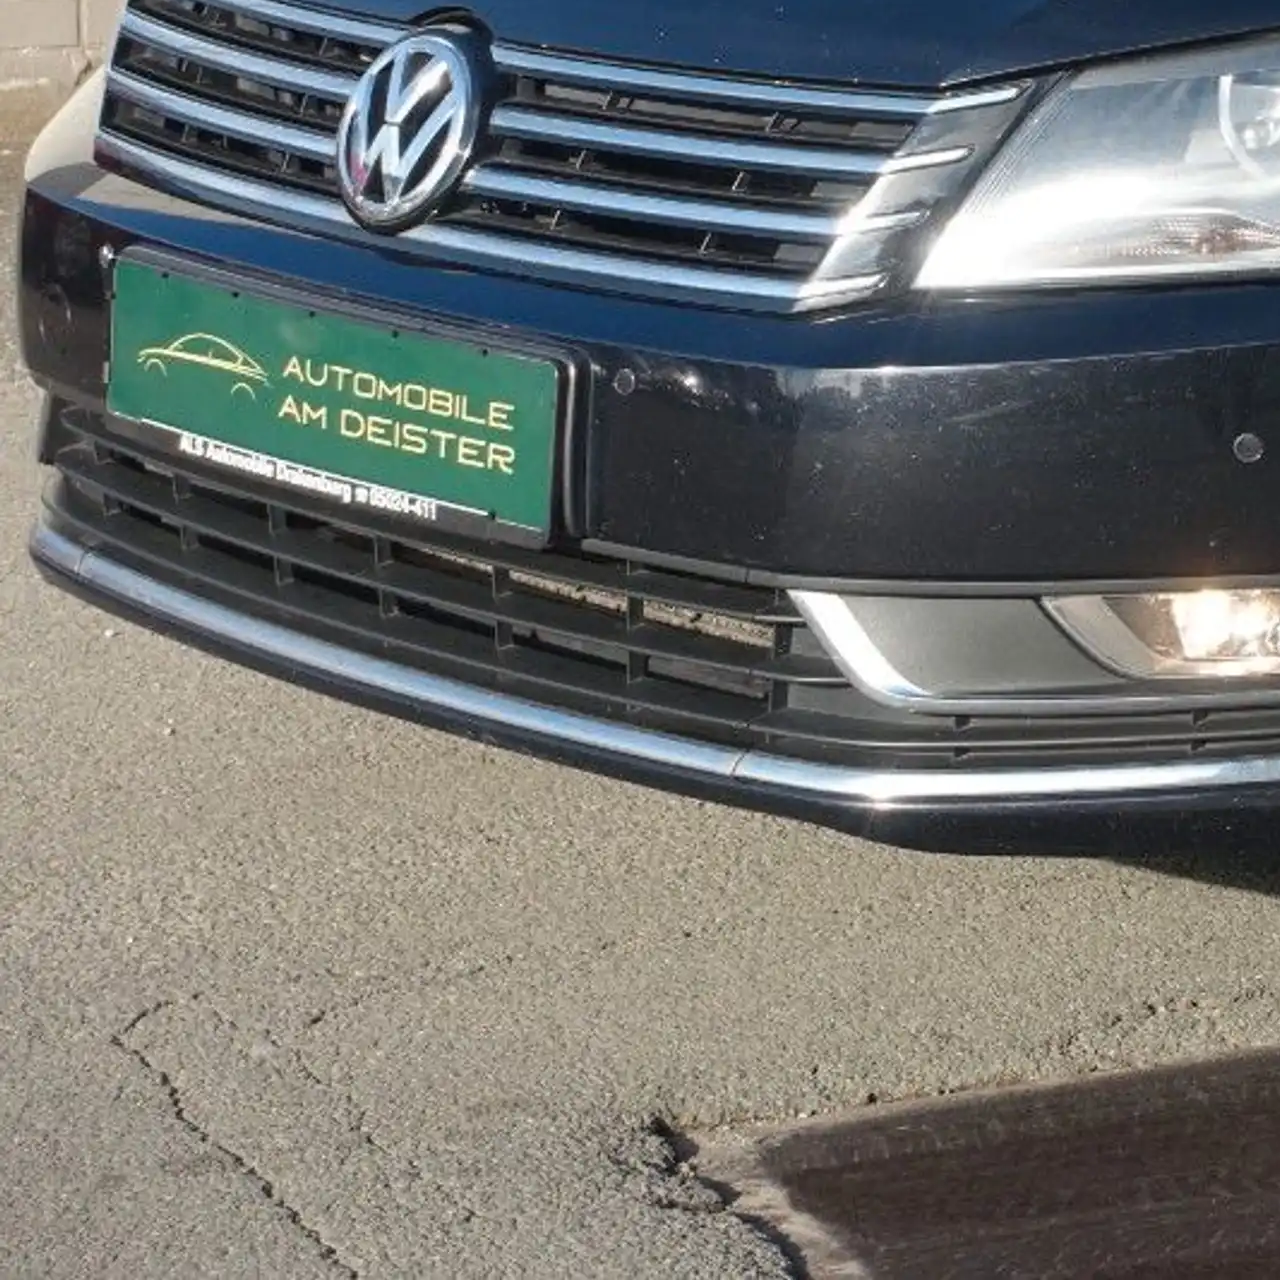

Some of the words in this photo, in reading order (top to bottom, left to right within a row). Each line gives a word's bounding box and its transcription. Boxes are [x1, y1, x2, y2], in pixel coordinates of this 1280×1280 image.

[282, 355, 516, 432] AUTOMOBILE
[277, 394, 328, 430] AM
[340, 407, 516, 476] DEISTER
